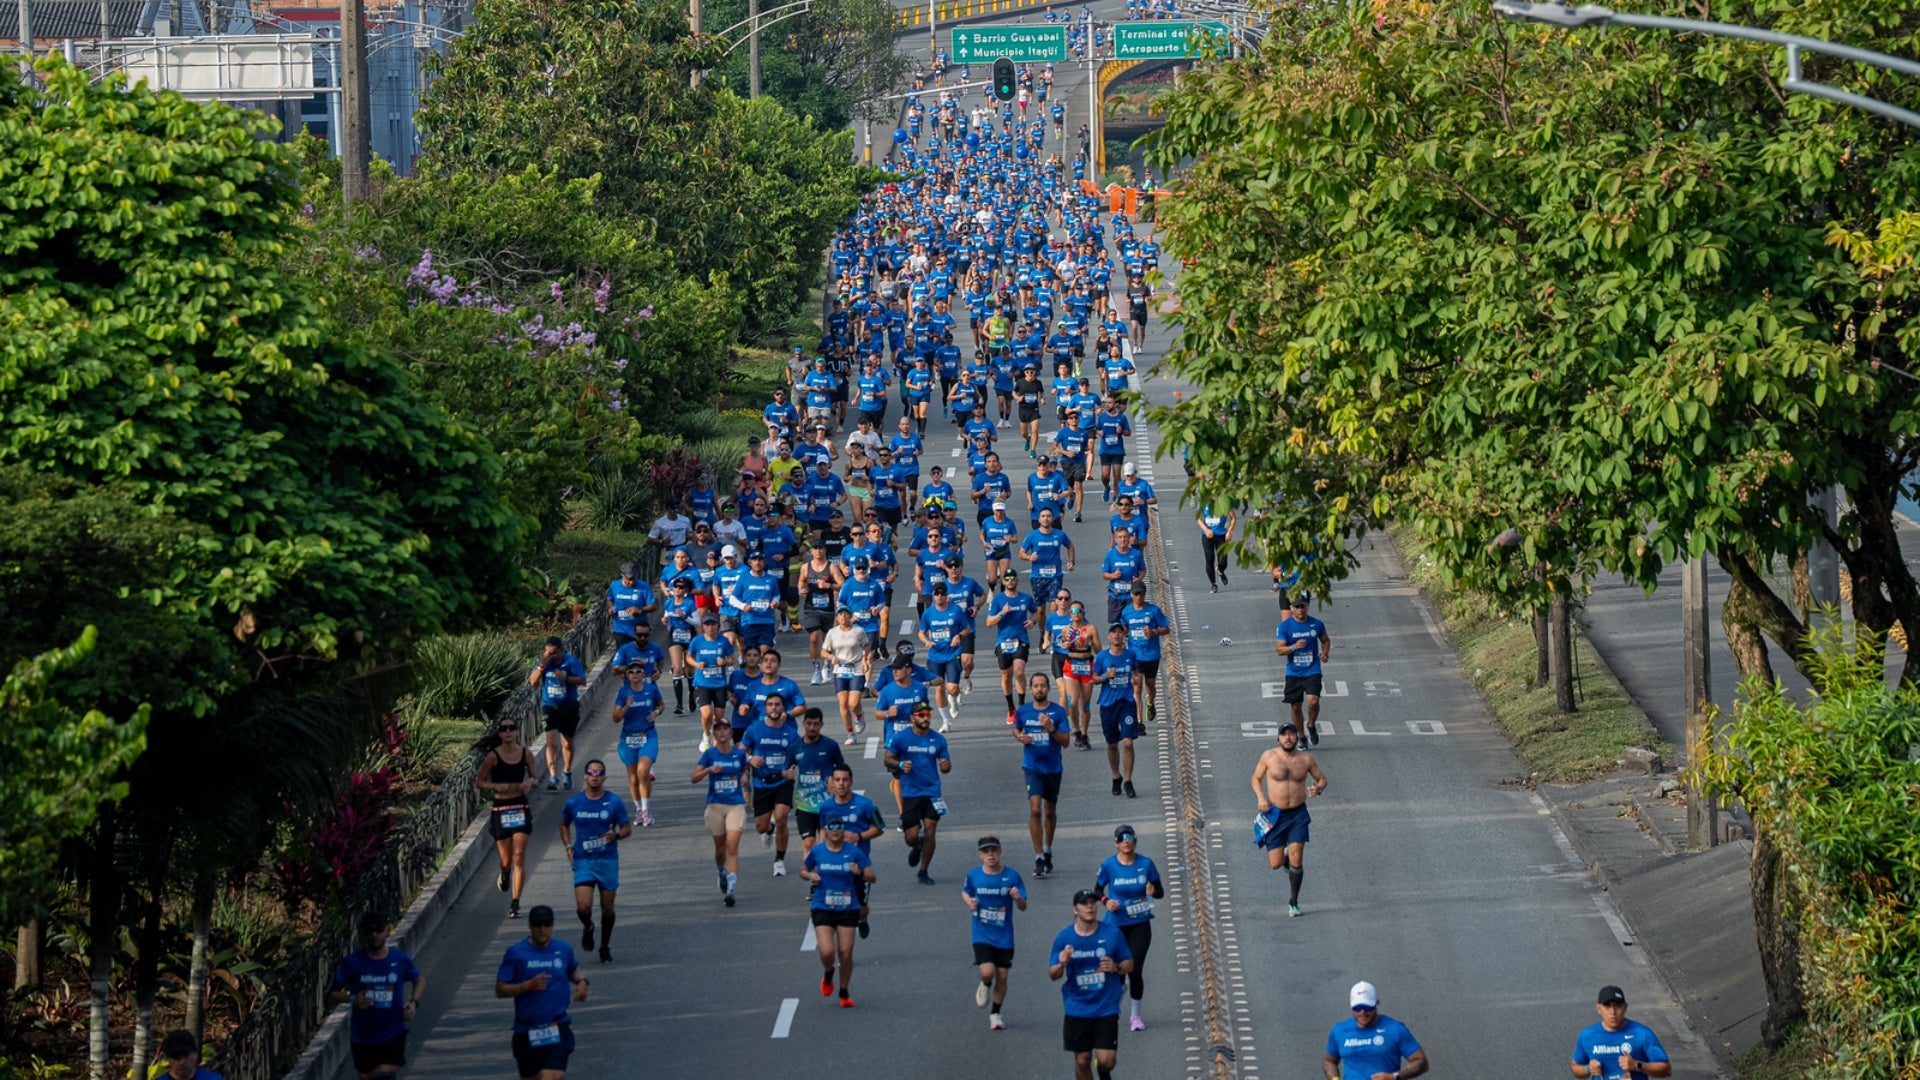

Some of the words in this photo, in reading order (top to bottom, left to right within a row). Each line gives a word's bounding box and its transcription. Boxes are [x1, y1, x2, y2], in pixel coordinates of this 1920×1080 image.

[1120, 29, 1167, 38] Terminal
[1171, 28, 1188, 38] del
[973, 34, 1006, 43] Barrio
[974, 48, 1024, 57] Municipio
[1028, 46, 1058, 58] Itagüí
[1120, 44, 1179, 54] Aeropuerto
[1240, 720, 1448, 737] SOLO
[527, 960, 552, 968] Allianz
[360, 975, 386, 983] Allianz
[1344, 1039, 1372, 1047] Allianz
[1592, 1045, 1620, 1054] Allianz
